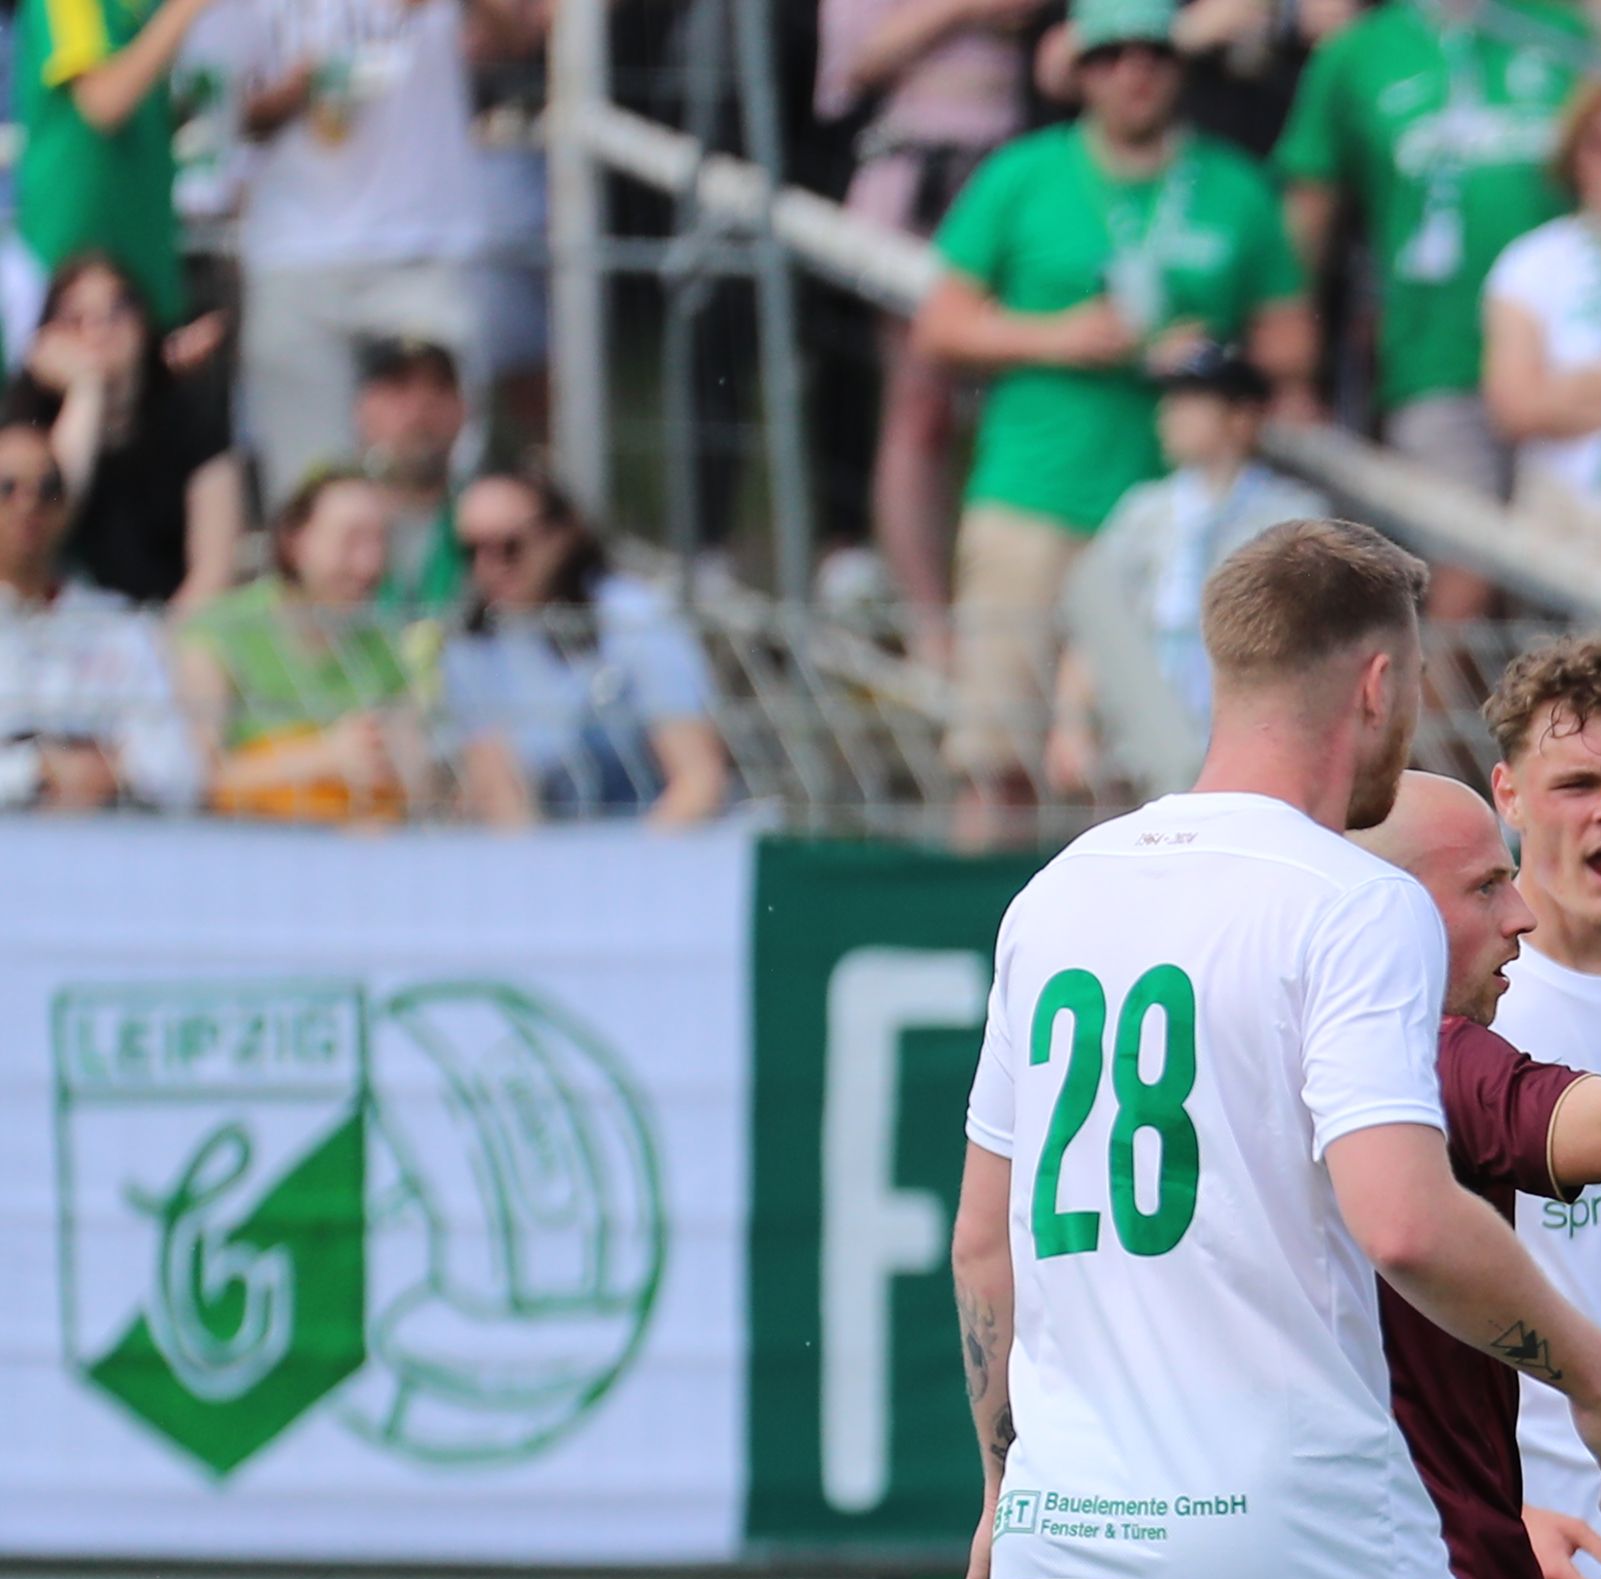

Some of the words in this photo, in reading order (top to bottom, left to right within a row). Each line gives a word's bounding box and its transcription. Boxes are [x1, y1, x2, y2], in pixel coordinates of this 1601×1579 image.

[71, 1009, 341, 1079] LEIPZIG
[1030, 962, 1200, 1261] 28
[1044, 1492, 1168, 1516] Bauelemente
[1174, 1494, 1247, 1517] GmbH
[1040, 1518, 1099, 1538] Fenster
[1104, 1523, 1116, 1539] &
[1121, 1522, 1167, 1540] Türen
